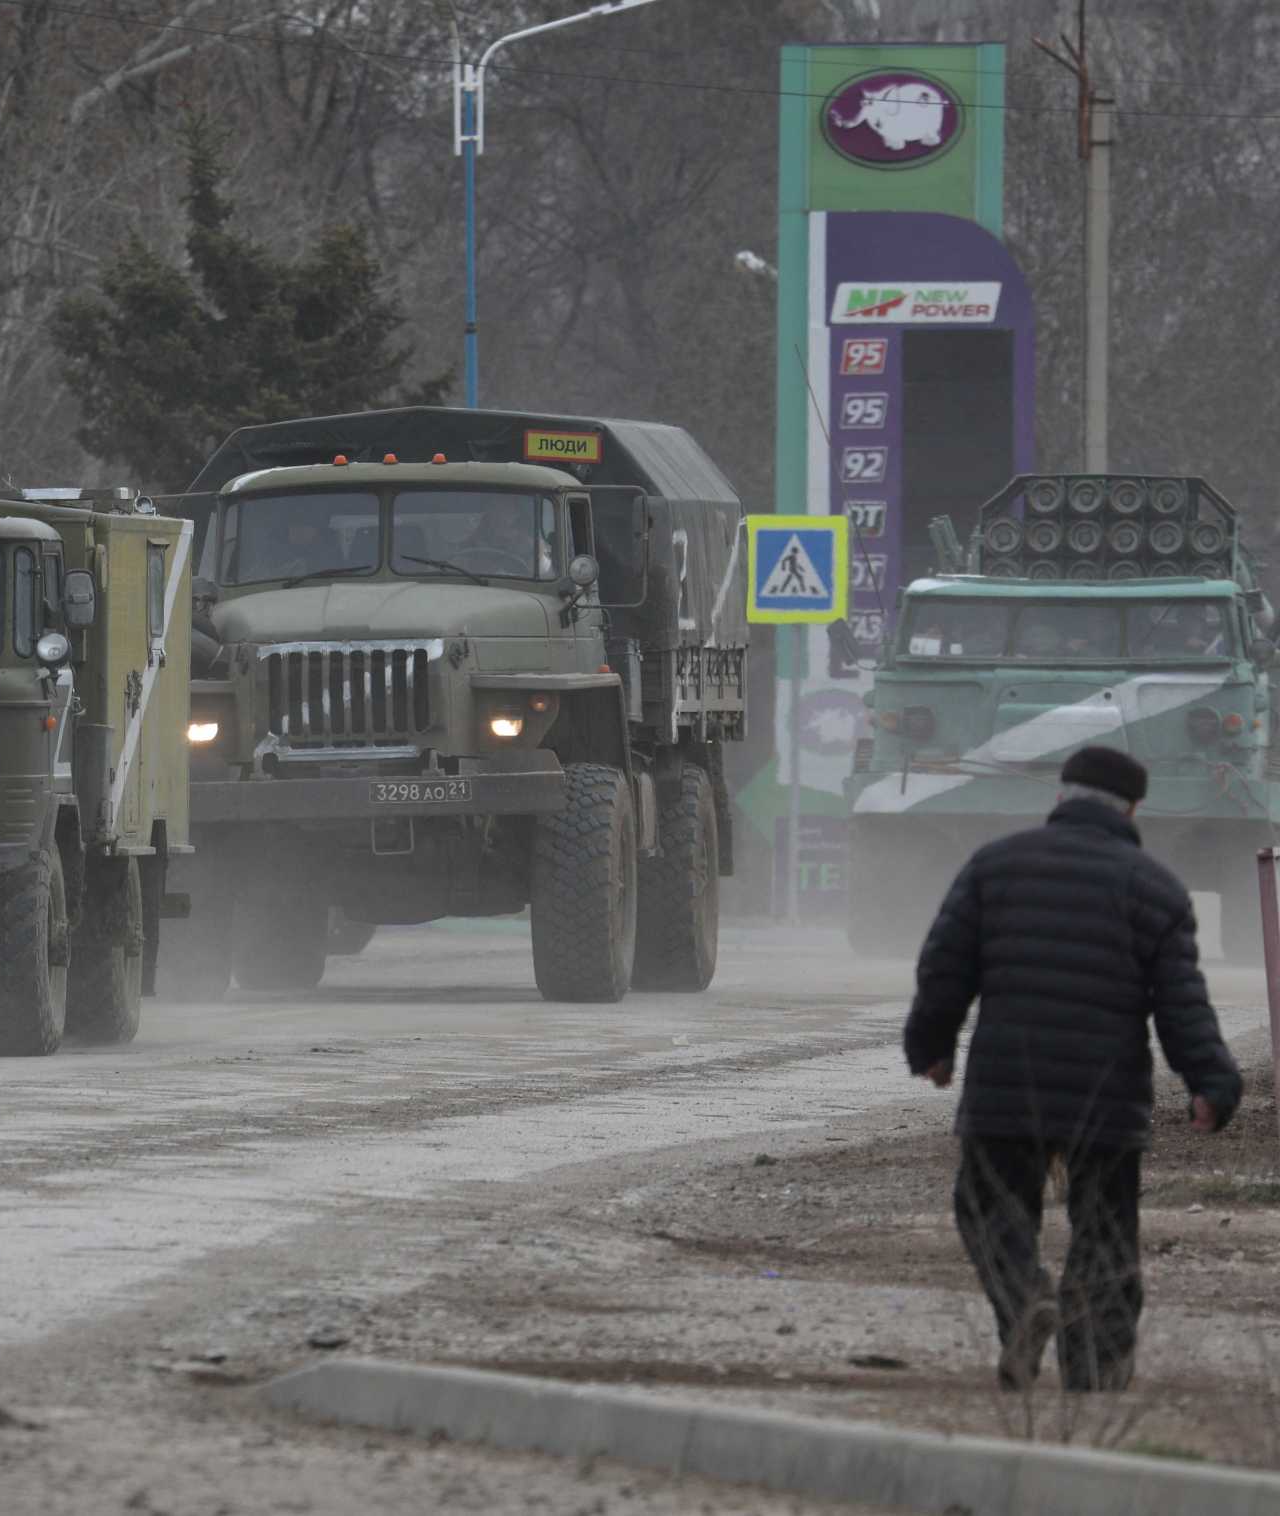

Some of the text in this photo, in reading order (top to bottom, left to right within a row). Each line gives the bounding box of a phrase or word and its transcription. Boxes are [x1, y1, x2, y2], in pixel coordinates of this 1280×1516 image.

[914, 290, 968, 303] NEW
[911, 304, 991, 317] POWER
[847, 343, 882, 366] 95
[847, 398, 883, 424] 95
[538, 438, 587, 455] ЛЮДИ
[847, 452, 883, 478] 92
[377, 784, 420, 801] 3298
[449, 782, 465, 795] 21
